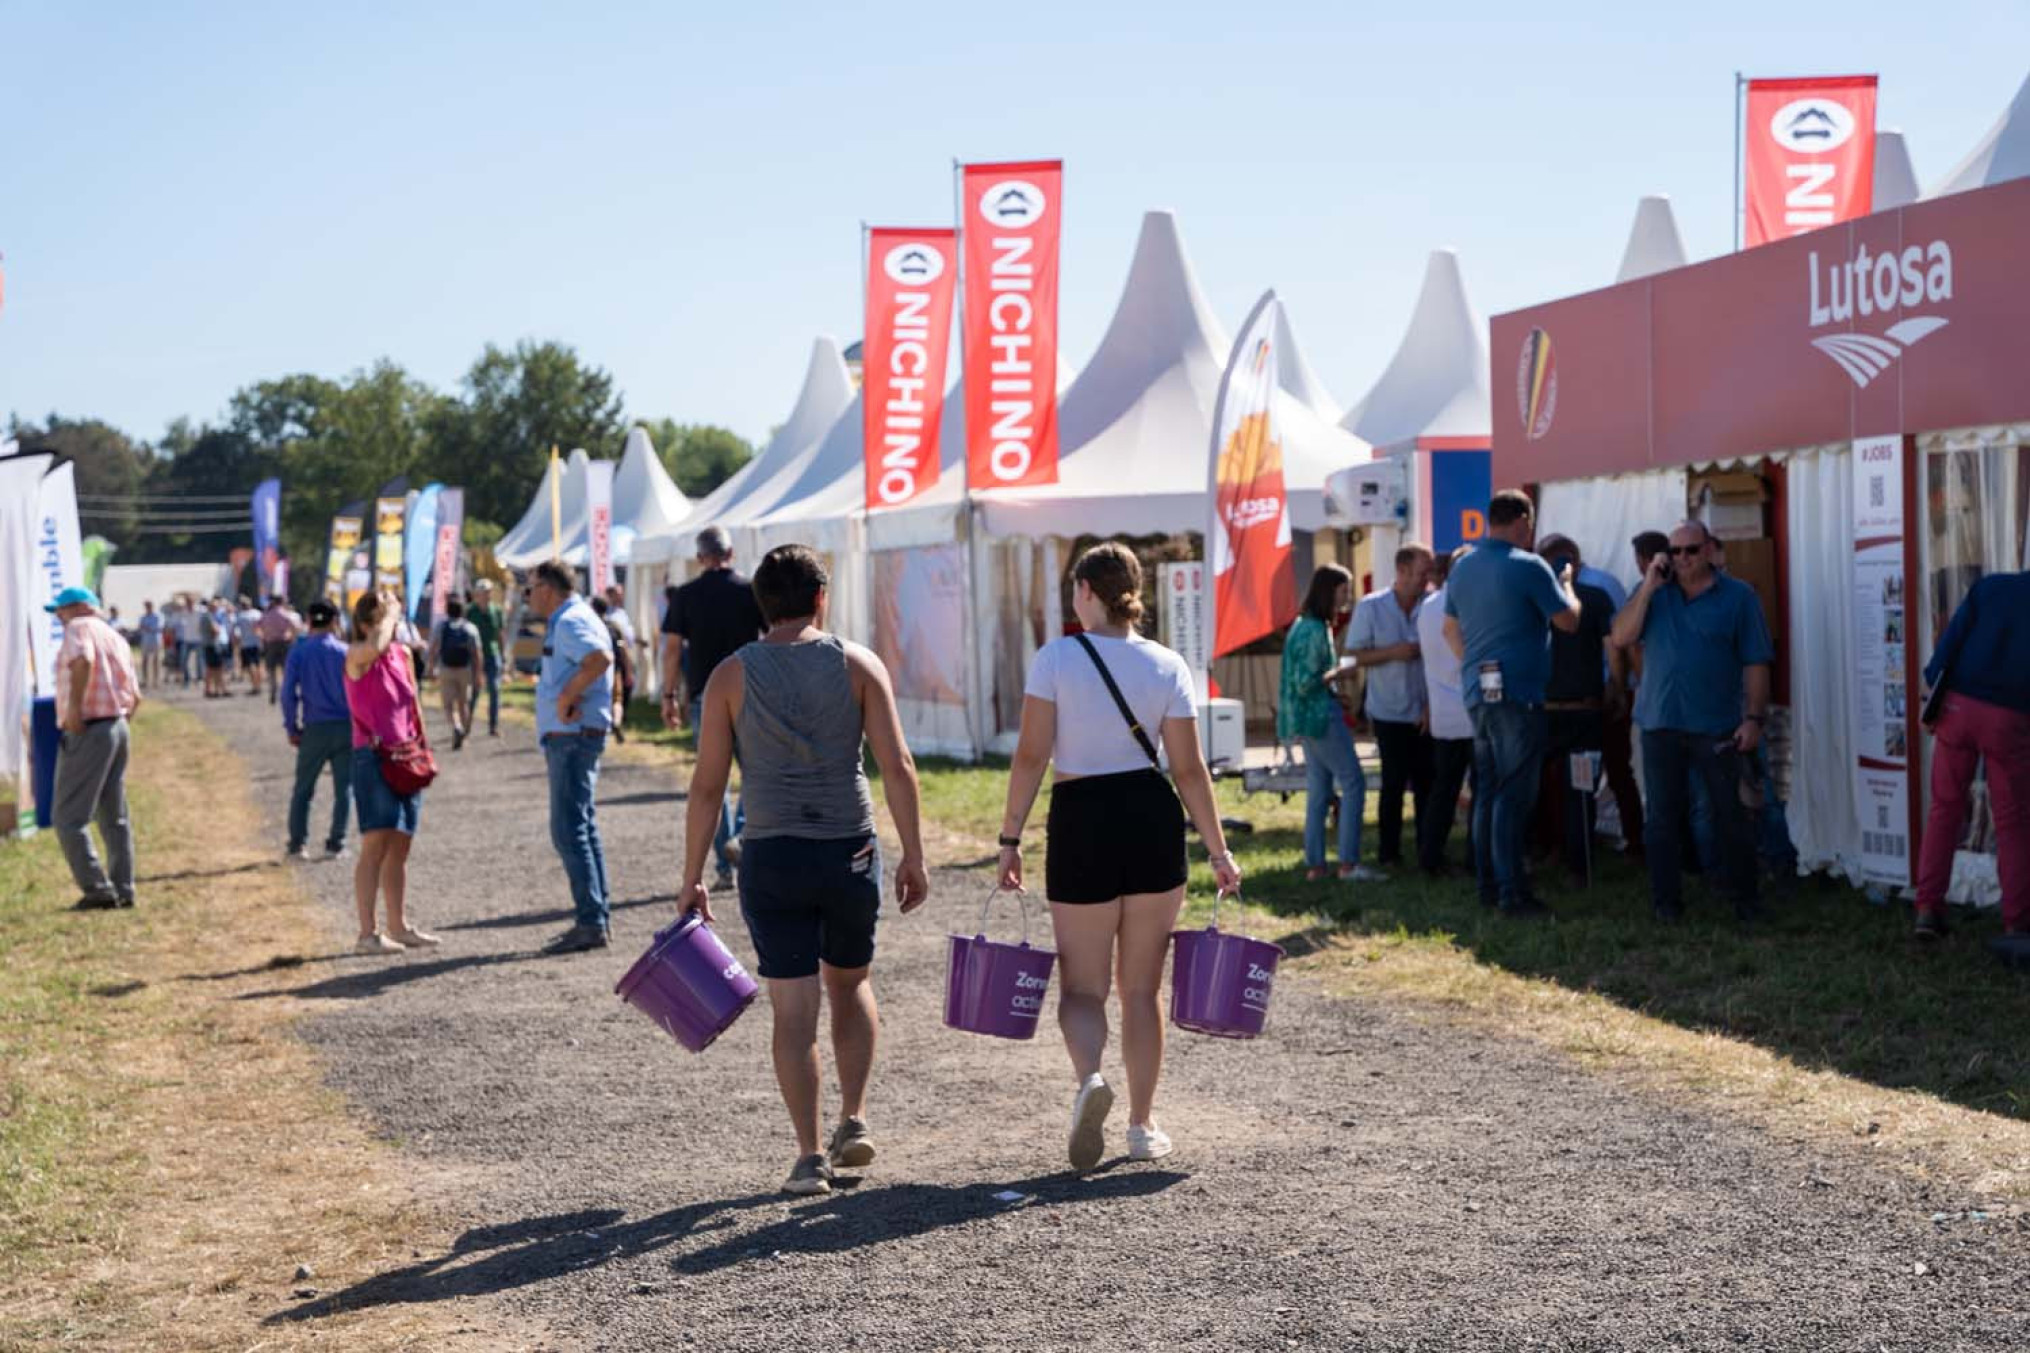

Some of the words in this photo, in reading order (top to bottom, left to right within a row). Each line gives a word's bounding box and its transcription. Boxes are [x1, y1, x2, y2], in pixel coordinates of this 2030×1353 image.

[990, 236, 1034, 480] NICHINO
[1808, 239, 1953, 327] Lutosa
[878, 291, 931, 503] NICHINO
